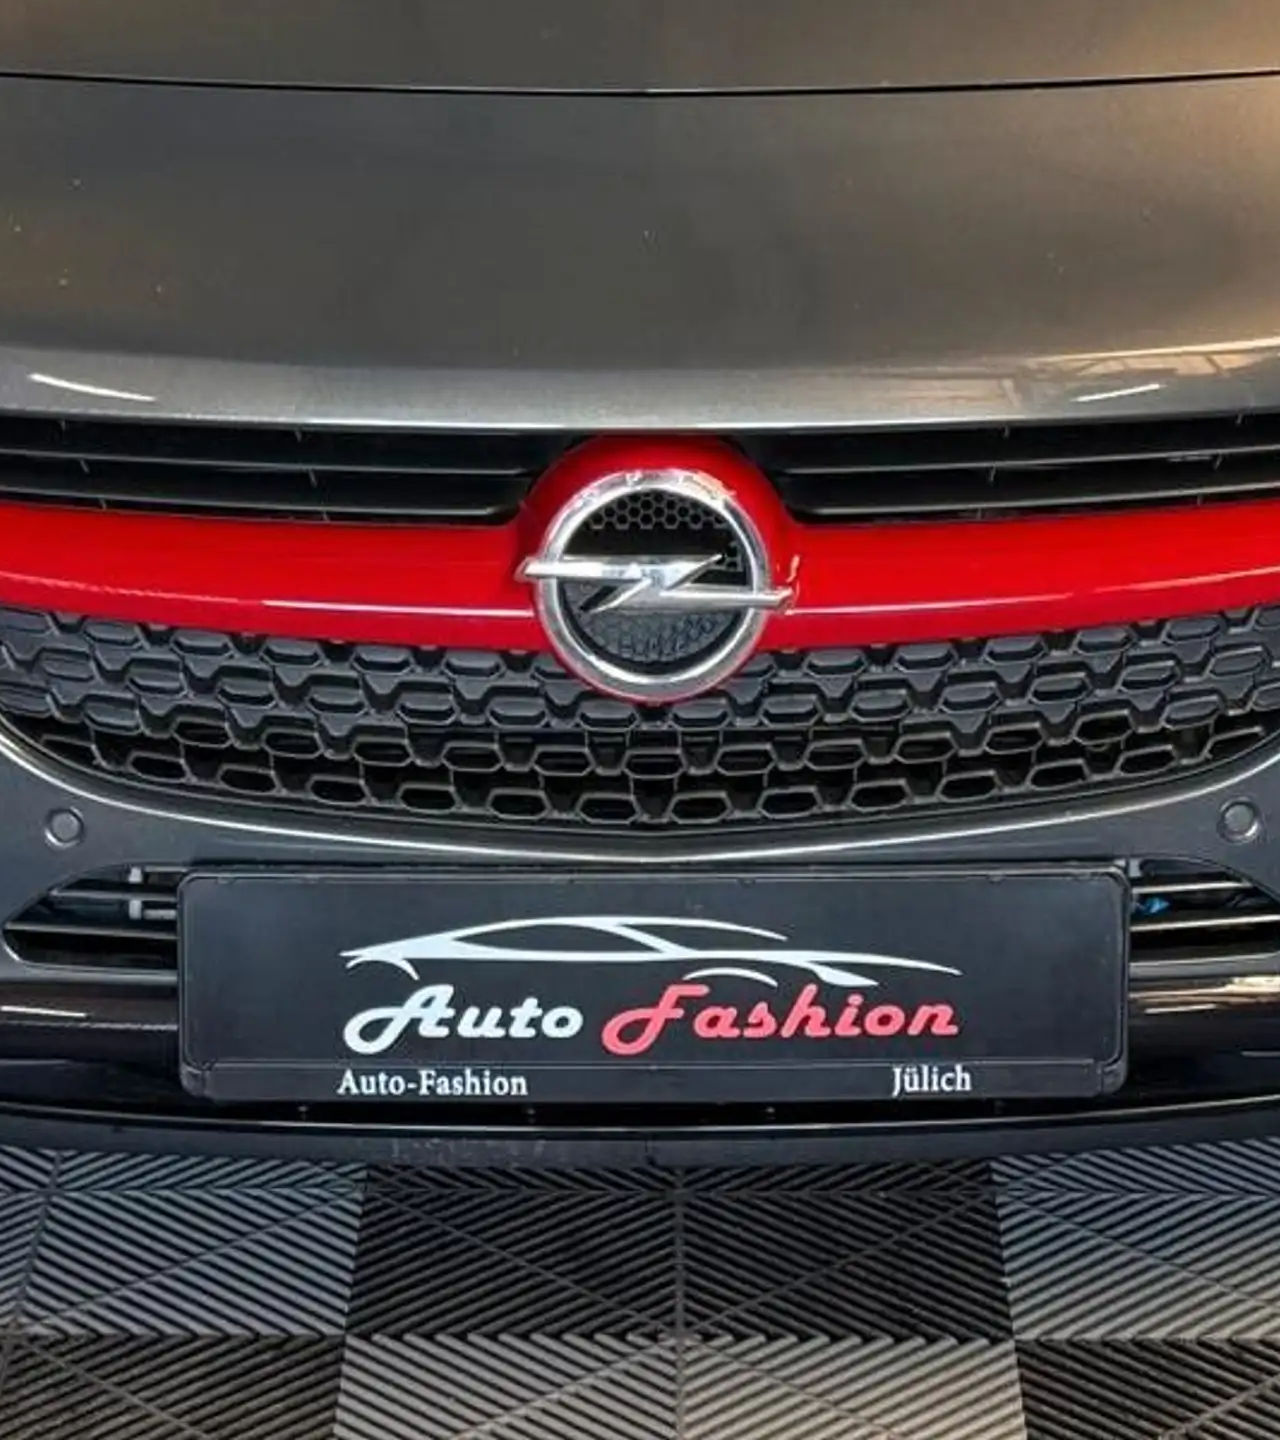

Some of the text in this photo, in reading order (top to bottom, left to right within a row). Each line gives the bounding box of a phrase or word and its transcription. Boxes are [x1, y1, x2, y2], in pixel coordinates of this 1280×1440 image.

[342, 982, 960, 1057] Auto Fashion
[336, 1066, 529, 1097] Auto-Fashion
[891, 1062, 973, 1097] Jülich
